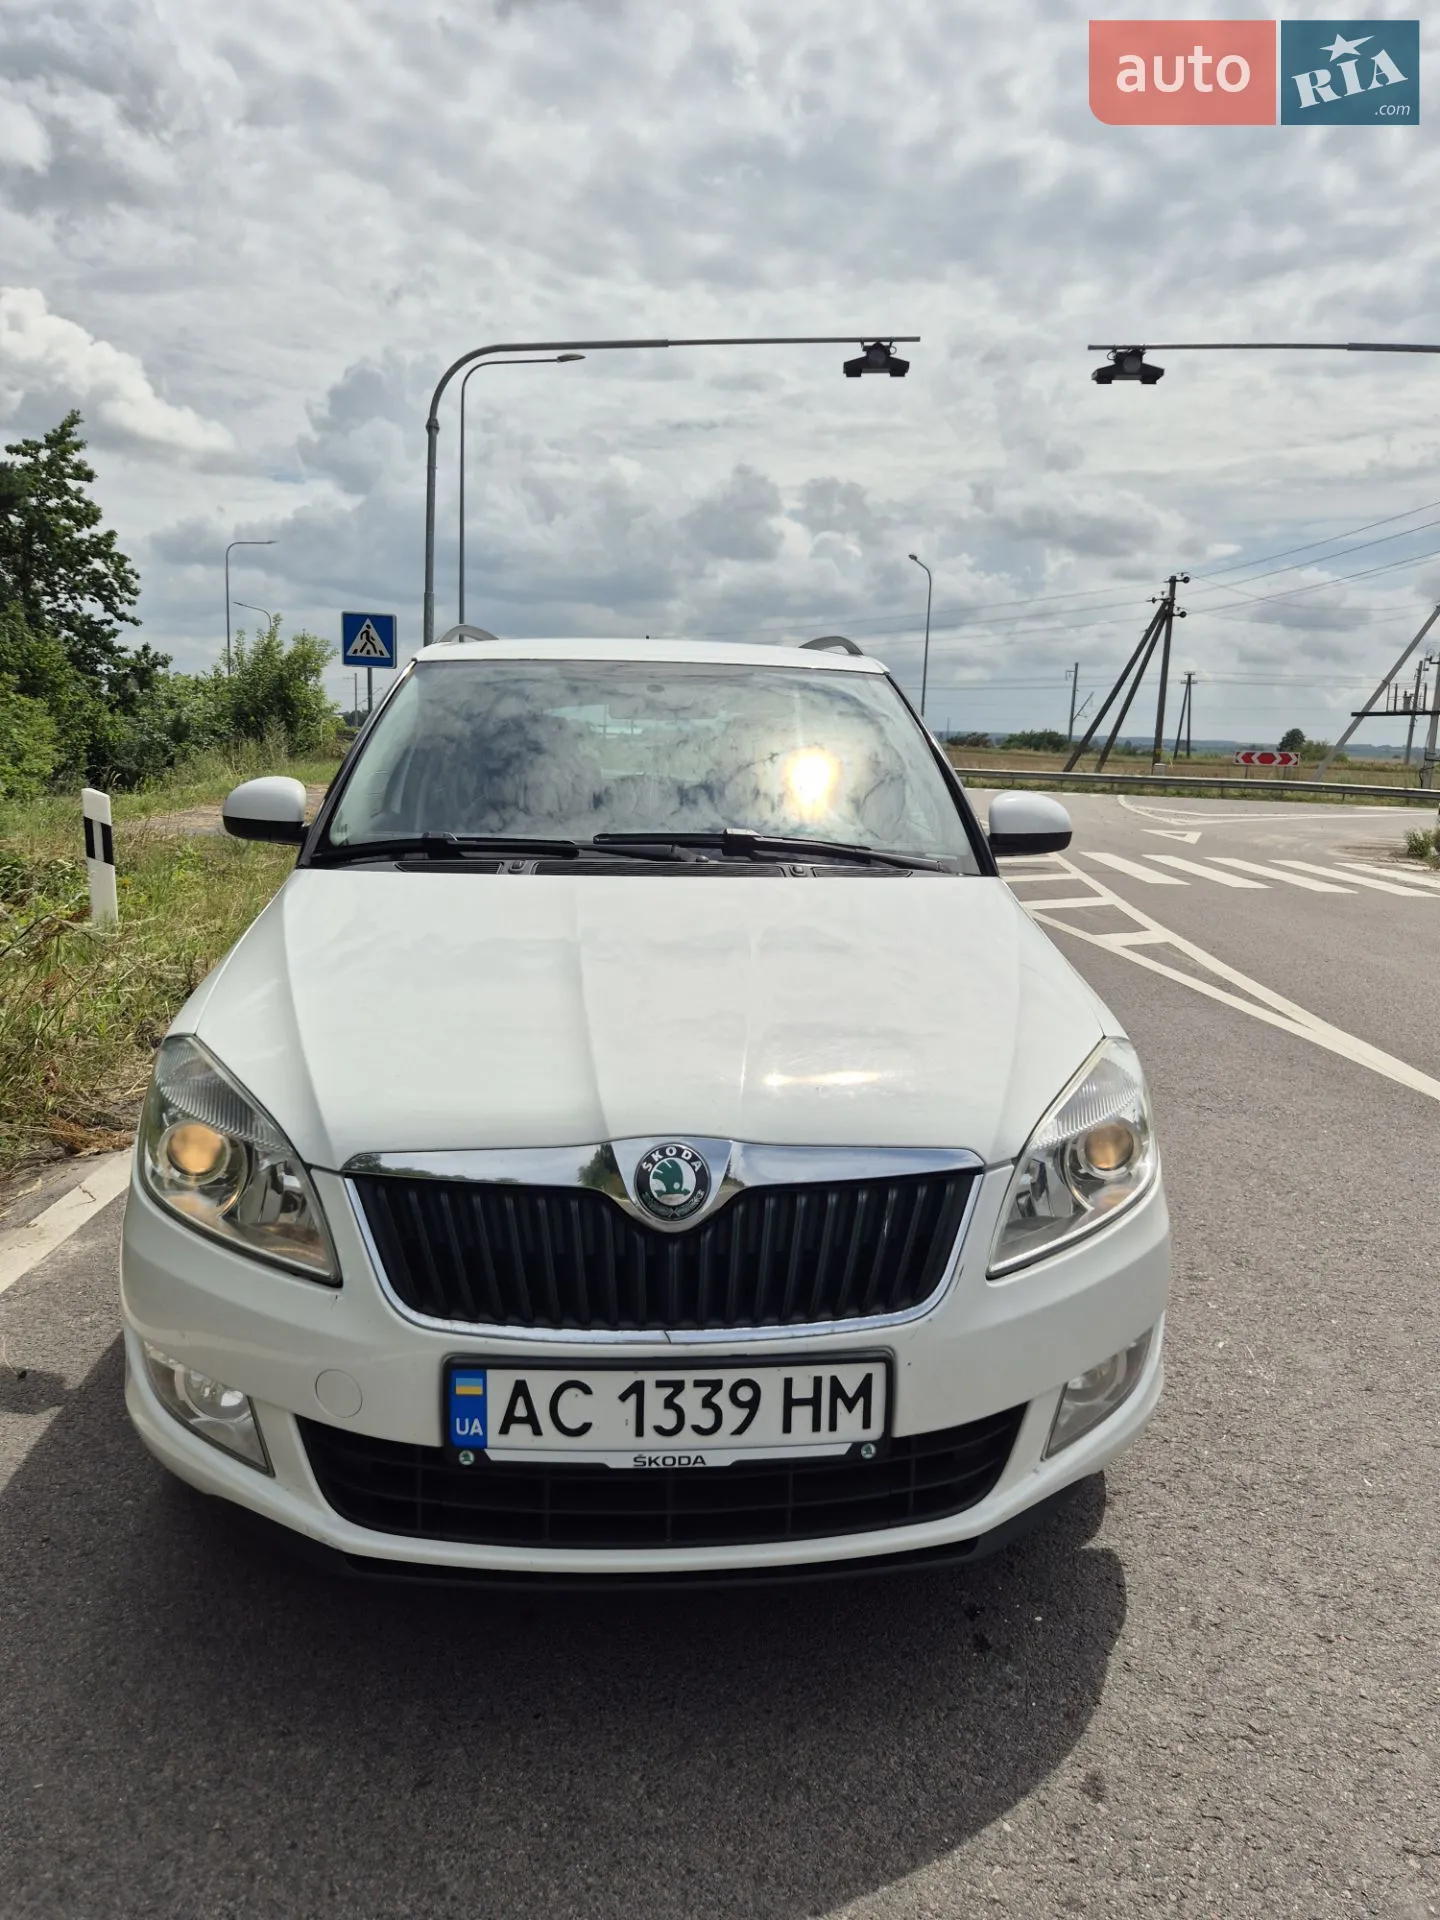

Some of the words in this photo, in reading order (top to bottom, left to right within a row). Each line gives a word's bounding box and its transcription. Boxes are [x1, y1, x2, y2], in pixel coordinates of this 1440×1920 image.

[498, 1379, 594, 1437] AC
[617, 1377, 762, 1438] 1339
[782, 1373, 873, 1434] HM
[455, 1417, 484, 1437] UA
